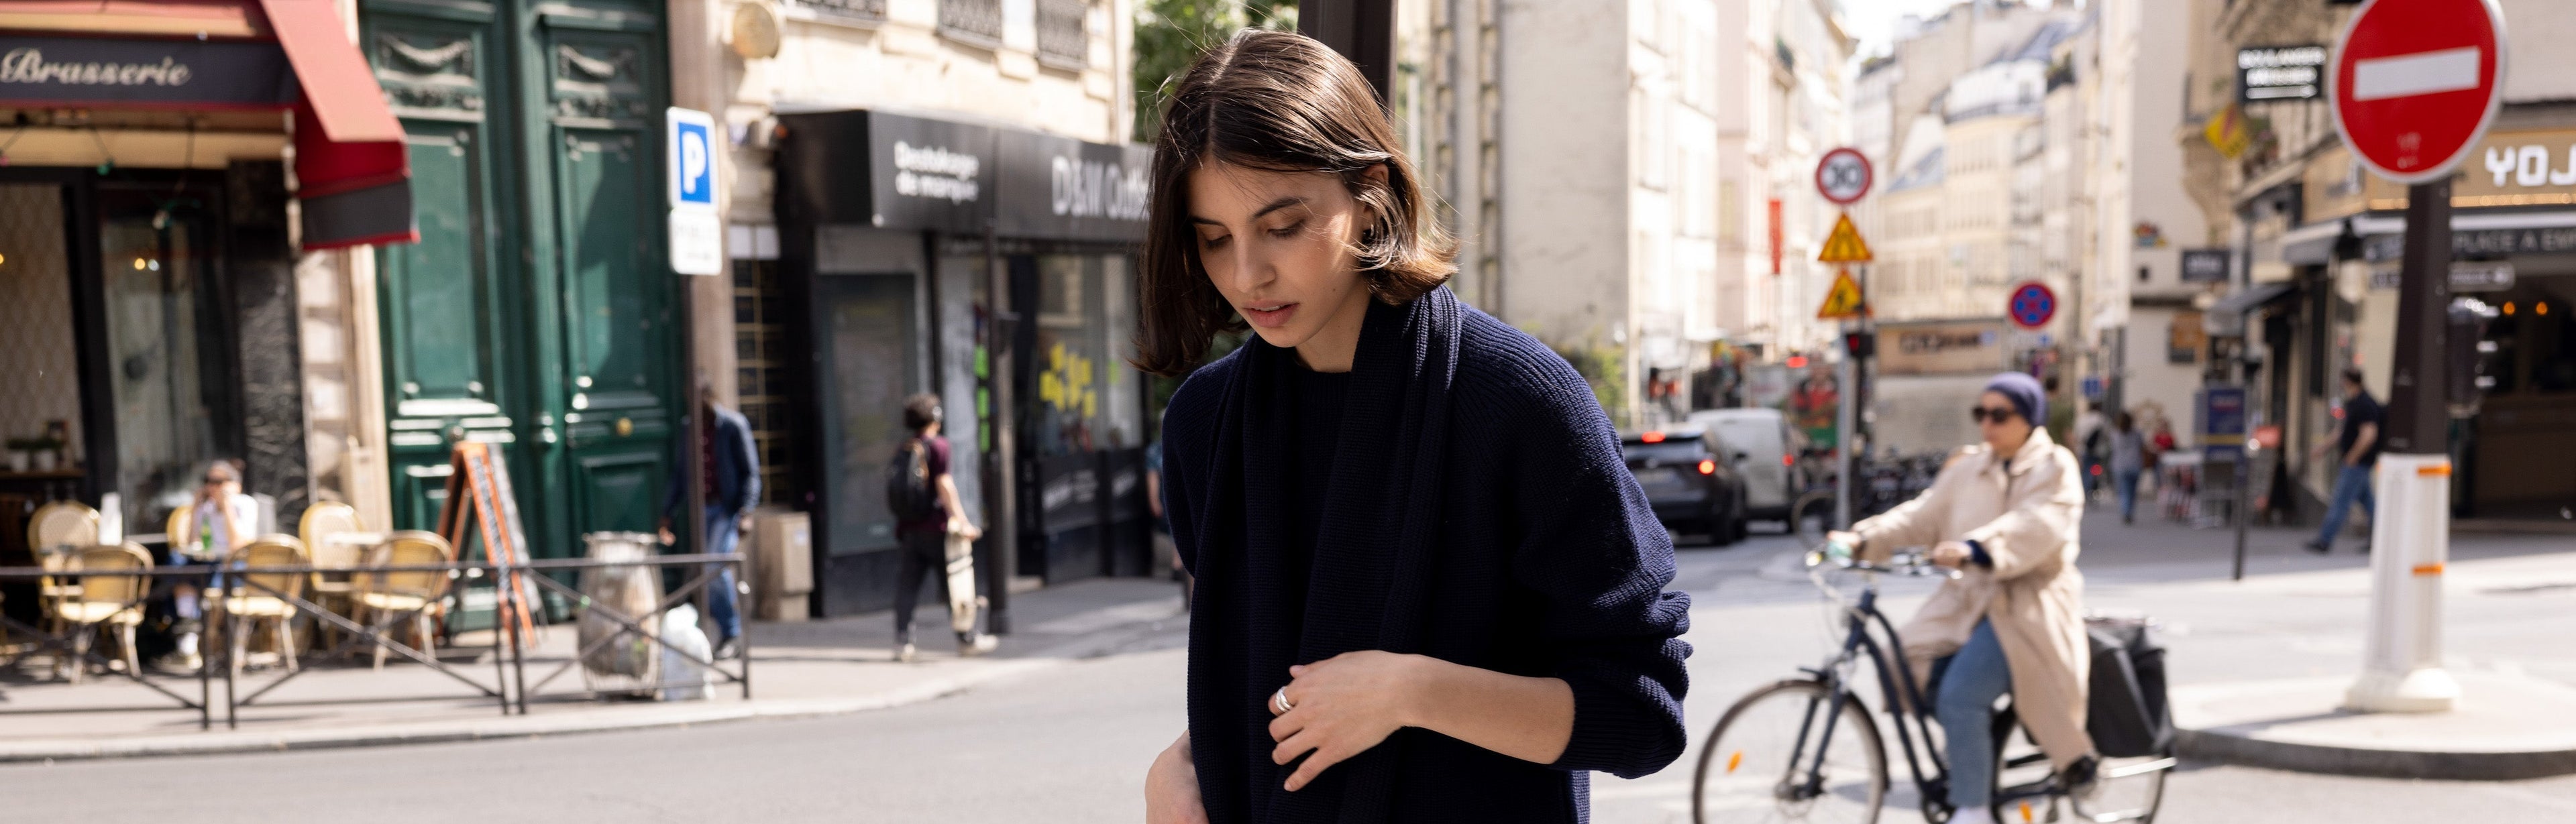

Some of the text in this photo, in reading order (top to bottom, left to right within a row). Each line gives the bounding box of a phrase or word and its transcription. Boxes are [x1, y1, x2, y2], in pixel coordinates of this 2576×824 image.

[0, 47, 193, 86] Brasserie
[682, 131, 706, 194] P
[1826, 162, 1864, 190] 30
